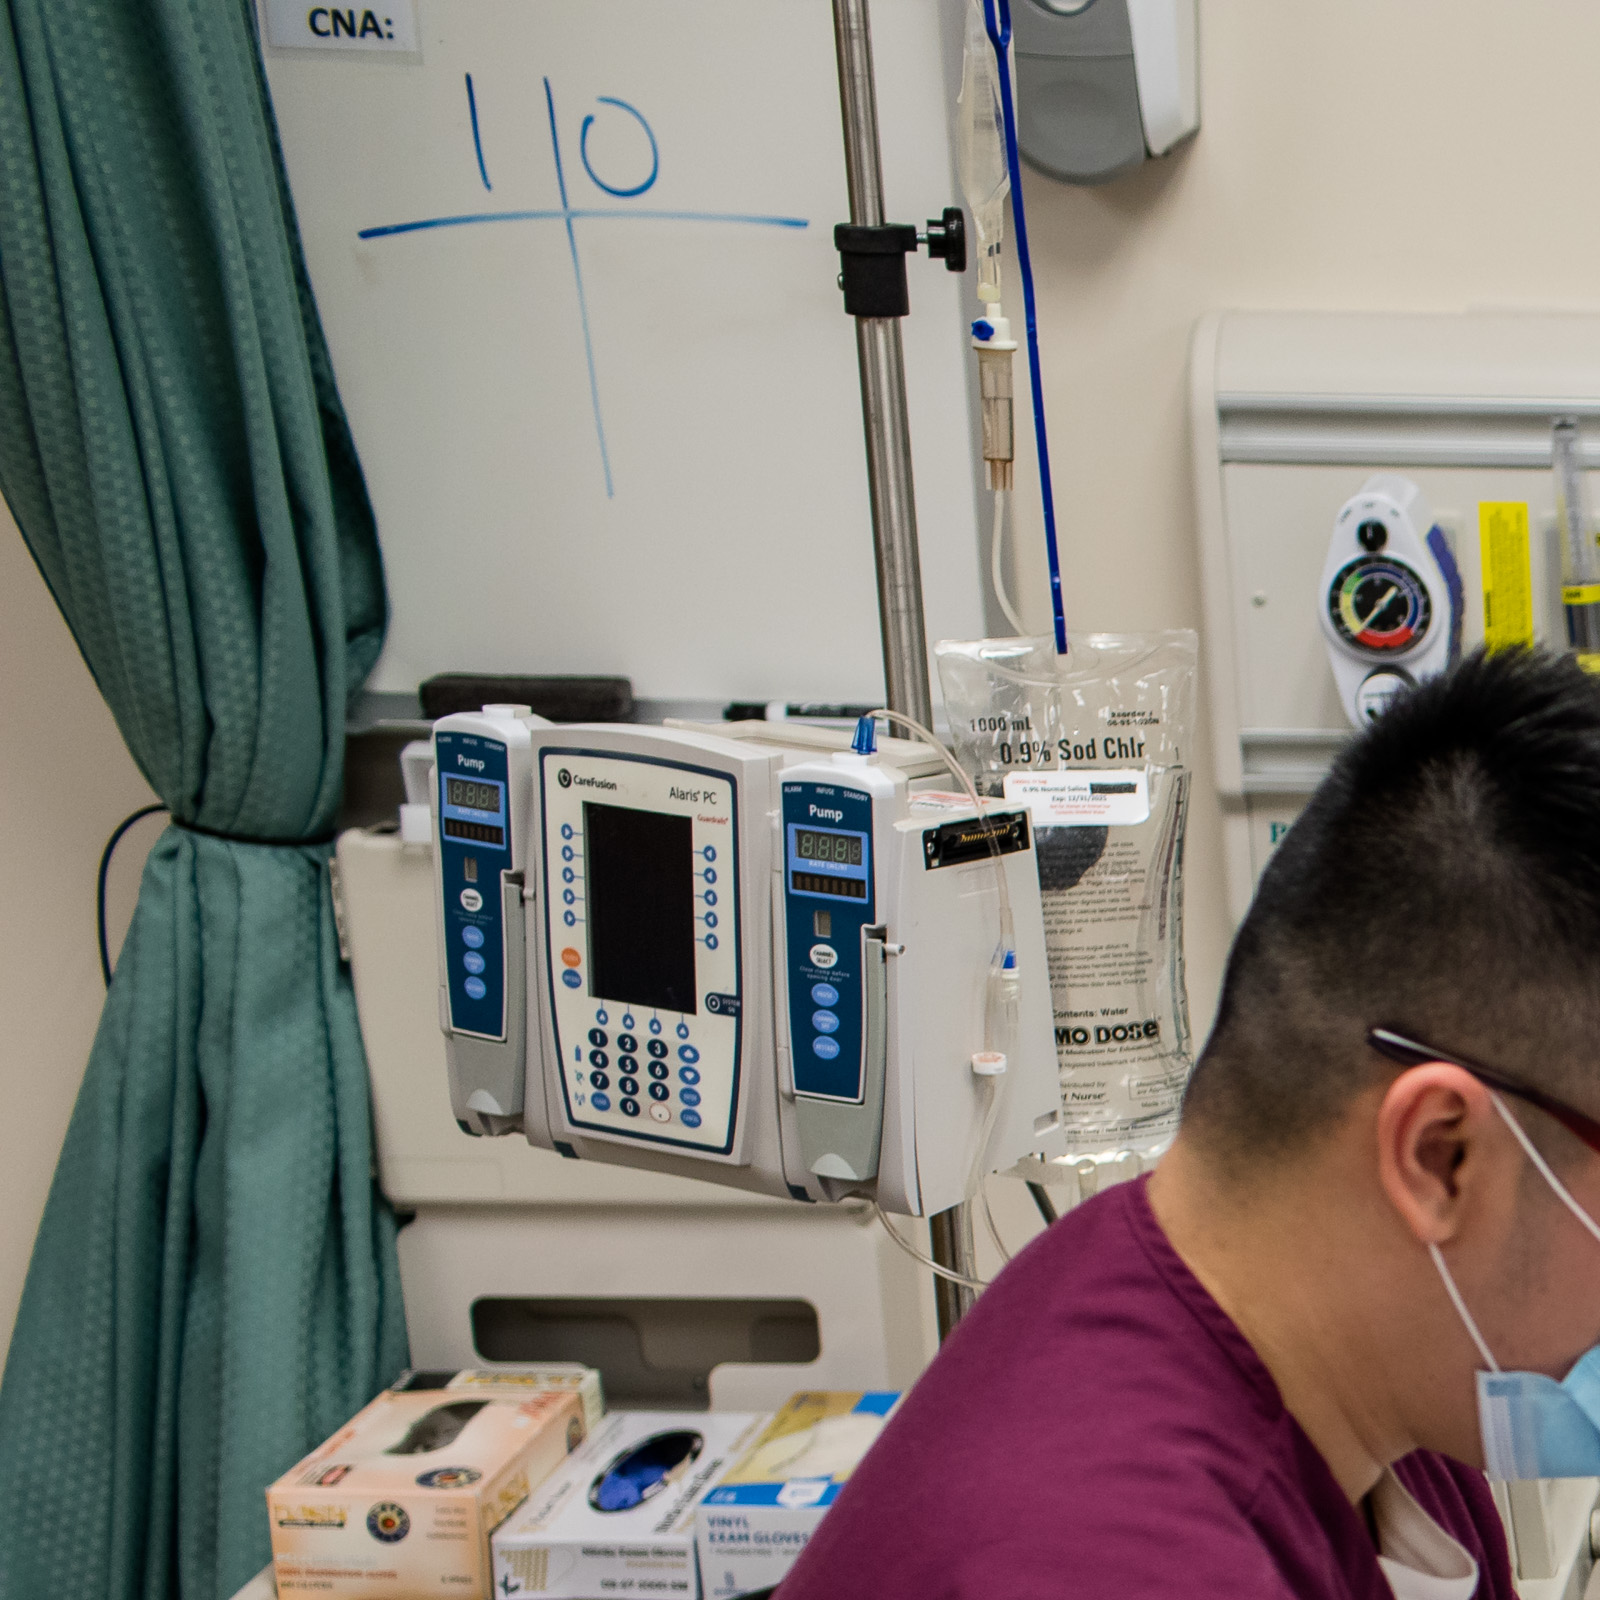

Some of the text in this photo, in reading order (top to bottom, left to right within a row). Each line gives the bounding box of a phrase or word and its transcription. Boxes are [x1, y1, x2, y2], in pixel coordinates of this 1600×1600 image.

[308, 7, 394, 39] CNA:
[970, 716, 1032, 732] 1000 mL
[1000, 736, 1145, 764] 0.9% Sod Chlr
[457, 754, 485, 772] Pump
[574, 775, 617, 791] CareFusion
[703, 791, 717, 805] PC
[843, 791, 868, 802] STANDBY
[809, 804, 843, 822] Pump
[1100, 1007, 1128, 1016] Water
[1054, 1026, 1091, 1046] MO
[1071, 1091, 1106, 1101] Nurse
[708, 1516, 749, 1528] VINYL
[708, 1531, 810, 1544] EXAM GLOVES
